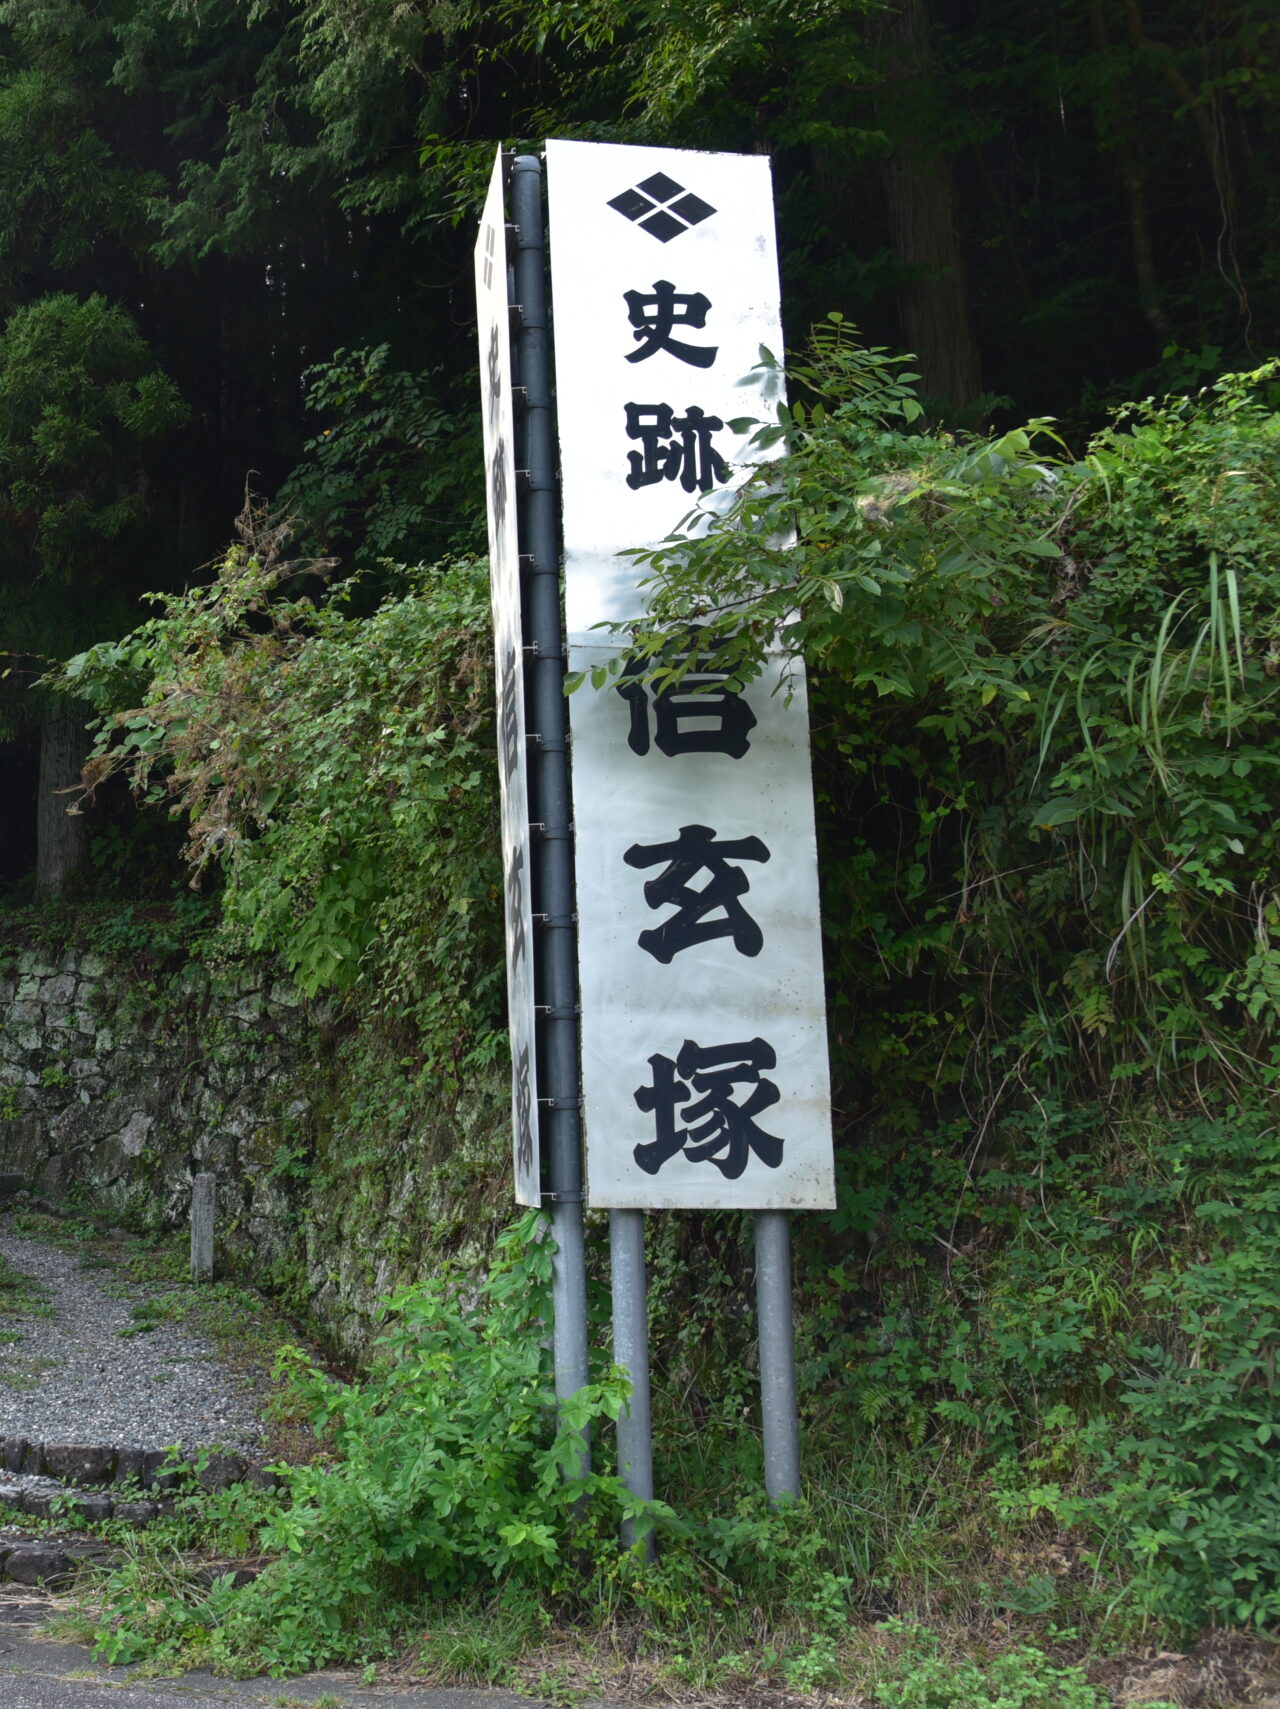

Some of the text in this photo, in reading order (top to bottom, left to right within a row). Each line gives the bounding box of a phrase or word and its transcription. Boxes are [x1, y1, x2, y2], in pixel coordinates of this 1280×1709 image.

[623, 279, 729, 494] 史跡
[502, 646, 533, 1178] 信玄塚
